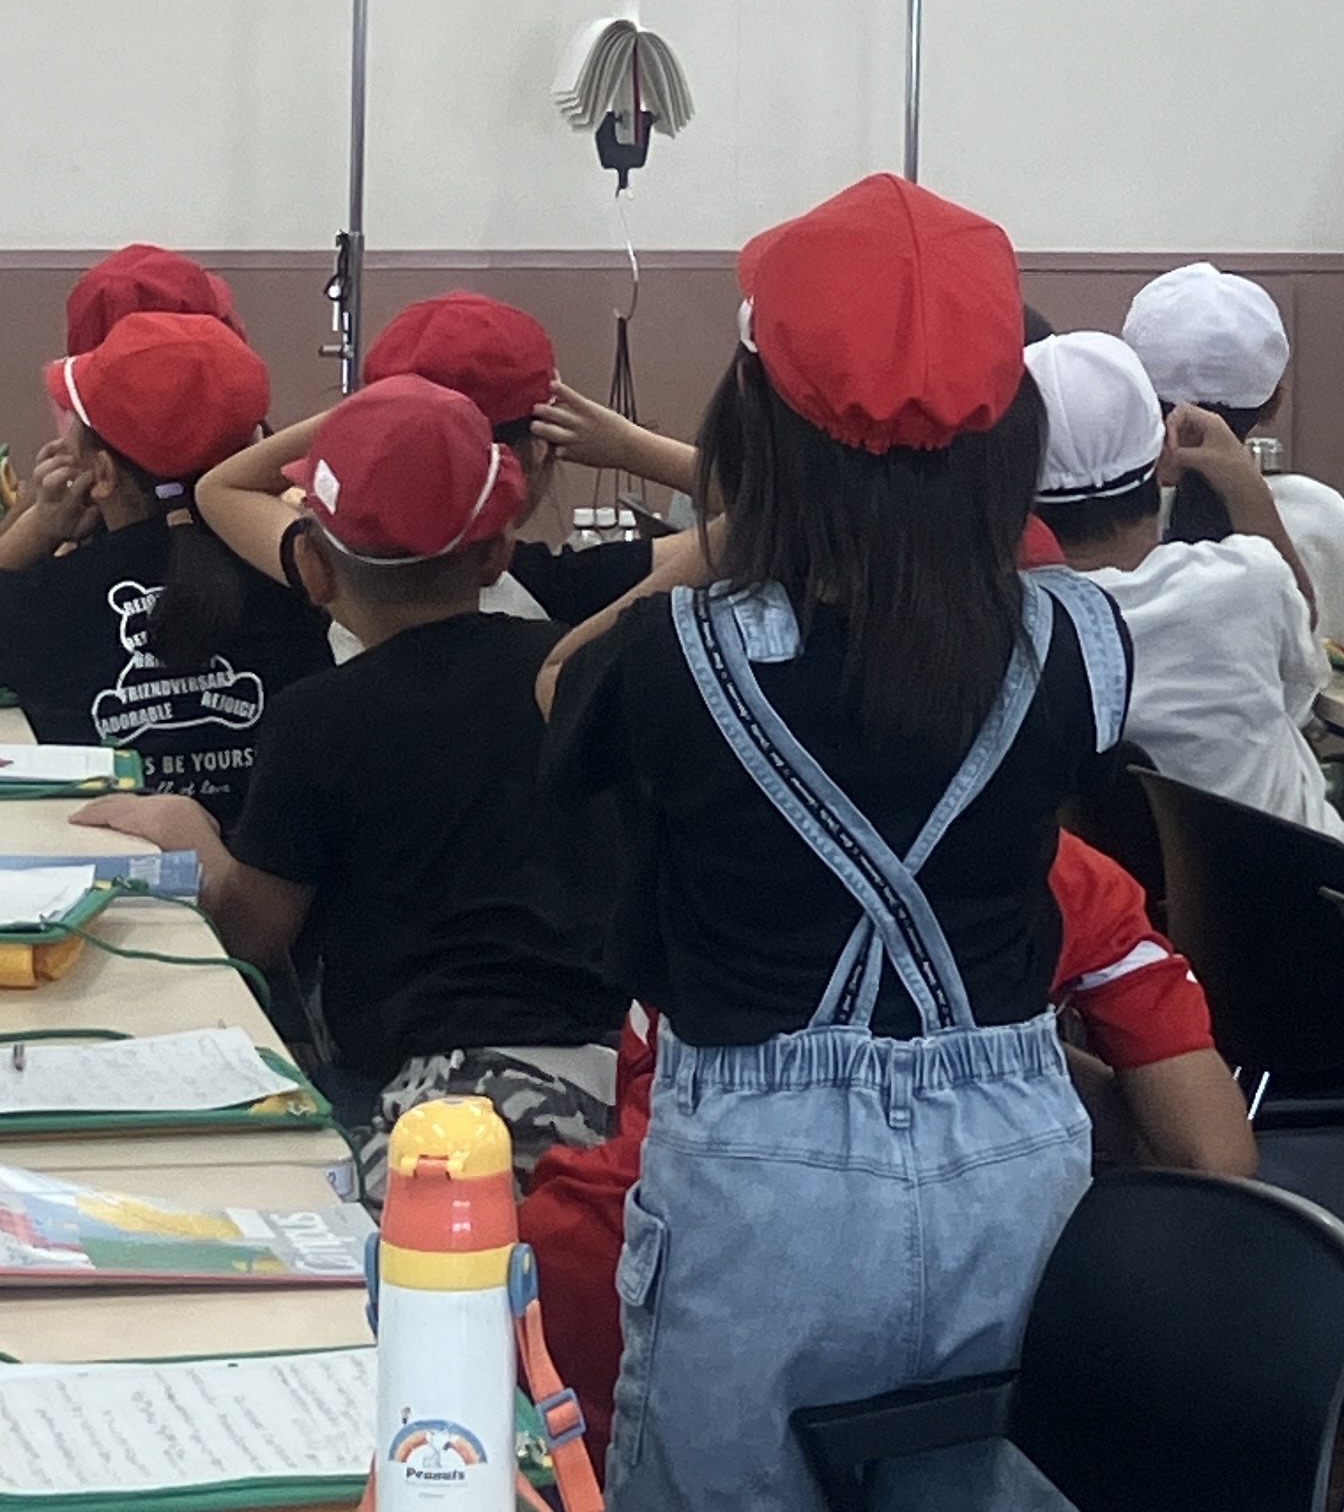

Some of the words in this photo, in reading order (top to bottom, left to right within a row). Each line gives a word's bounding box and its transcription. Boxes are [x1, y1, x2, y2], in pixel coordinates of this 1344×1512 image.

[100, 701, 174, 735] ADORABLE
[201, 690, 256, 720] REJOICE
[162, 754, 185, 775] BE
